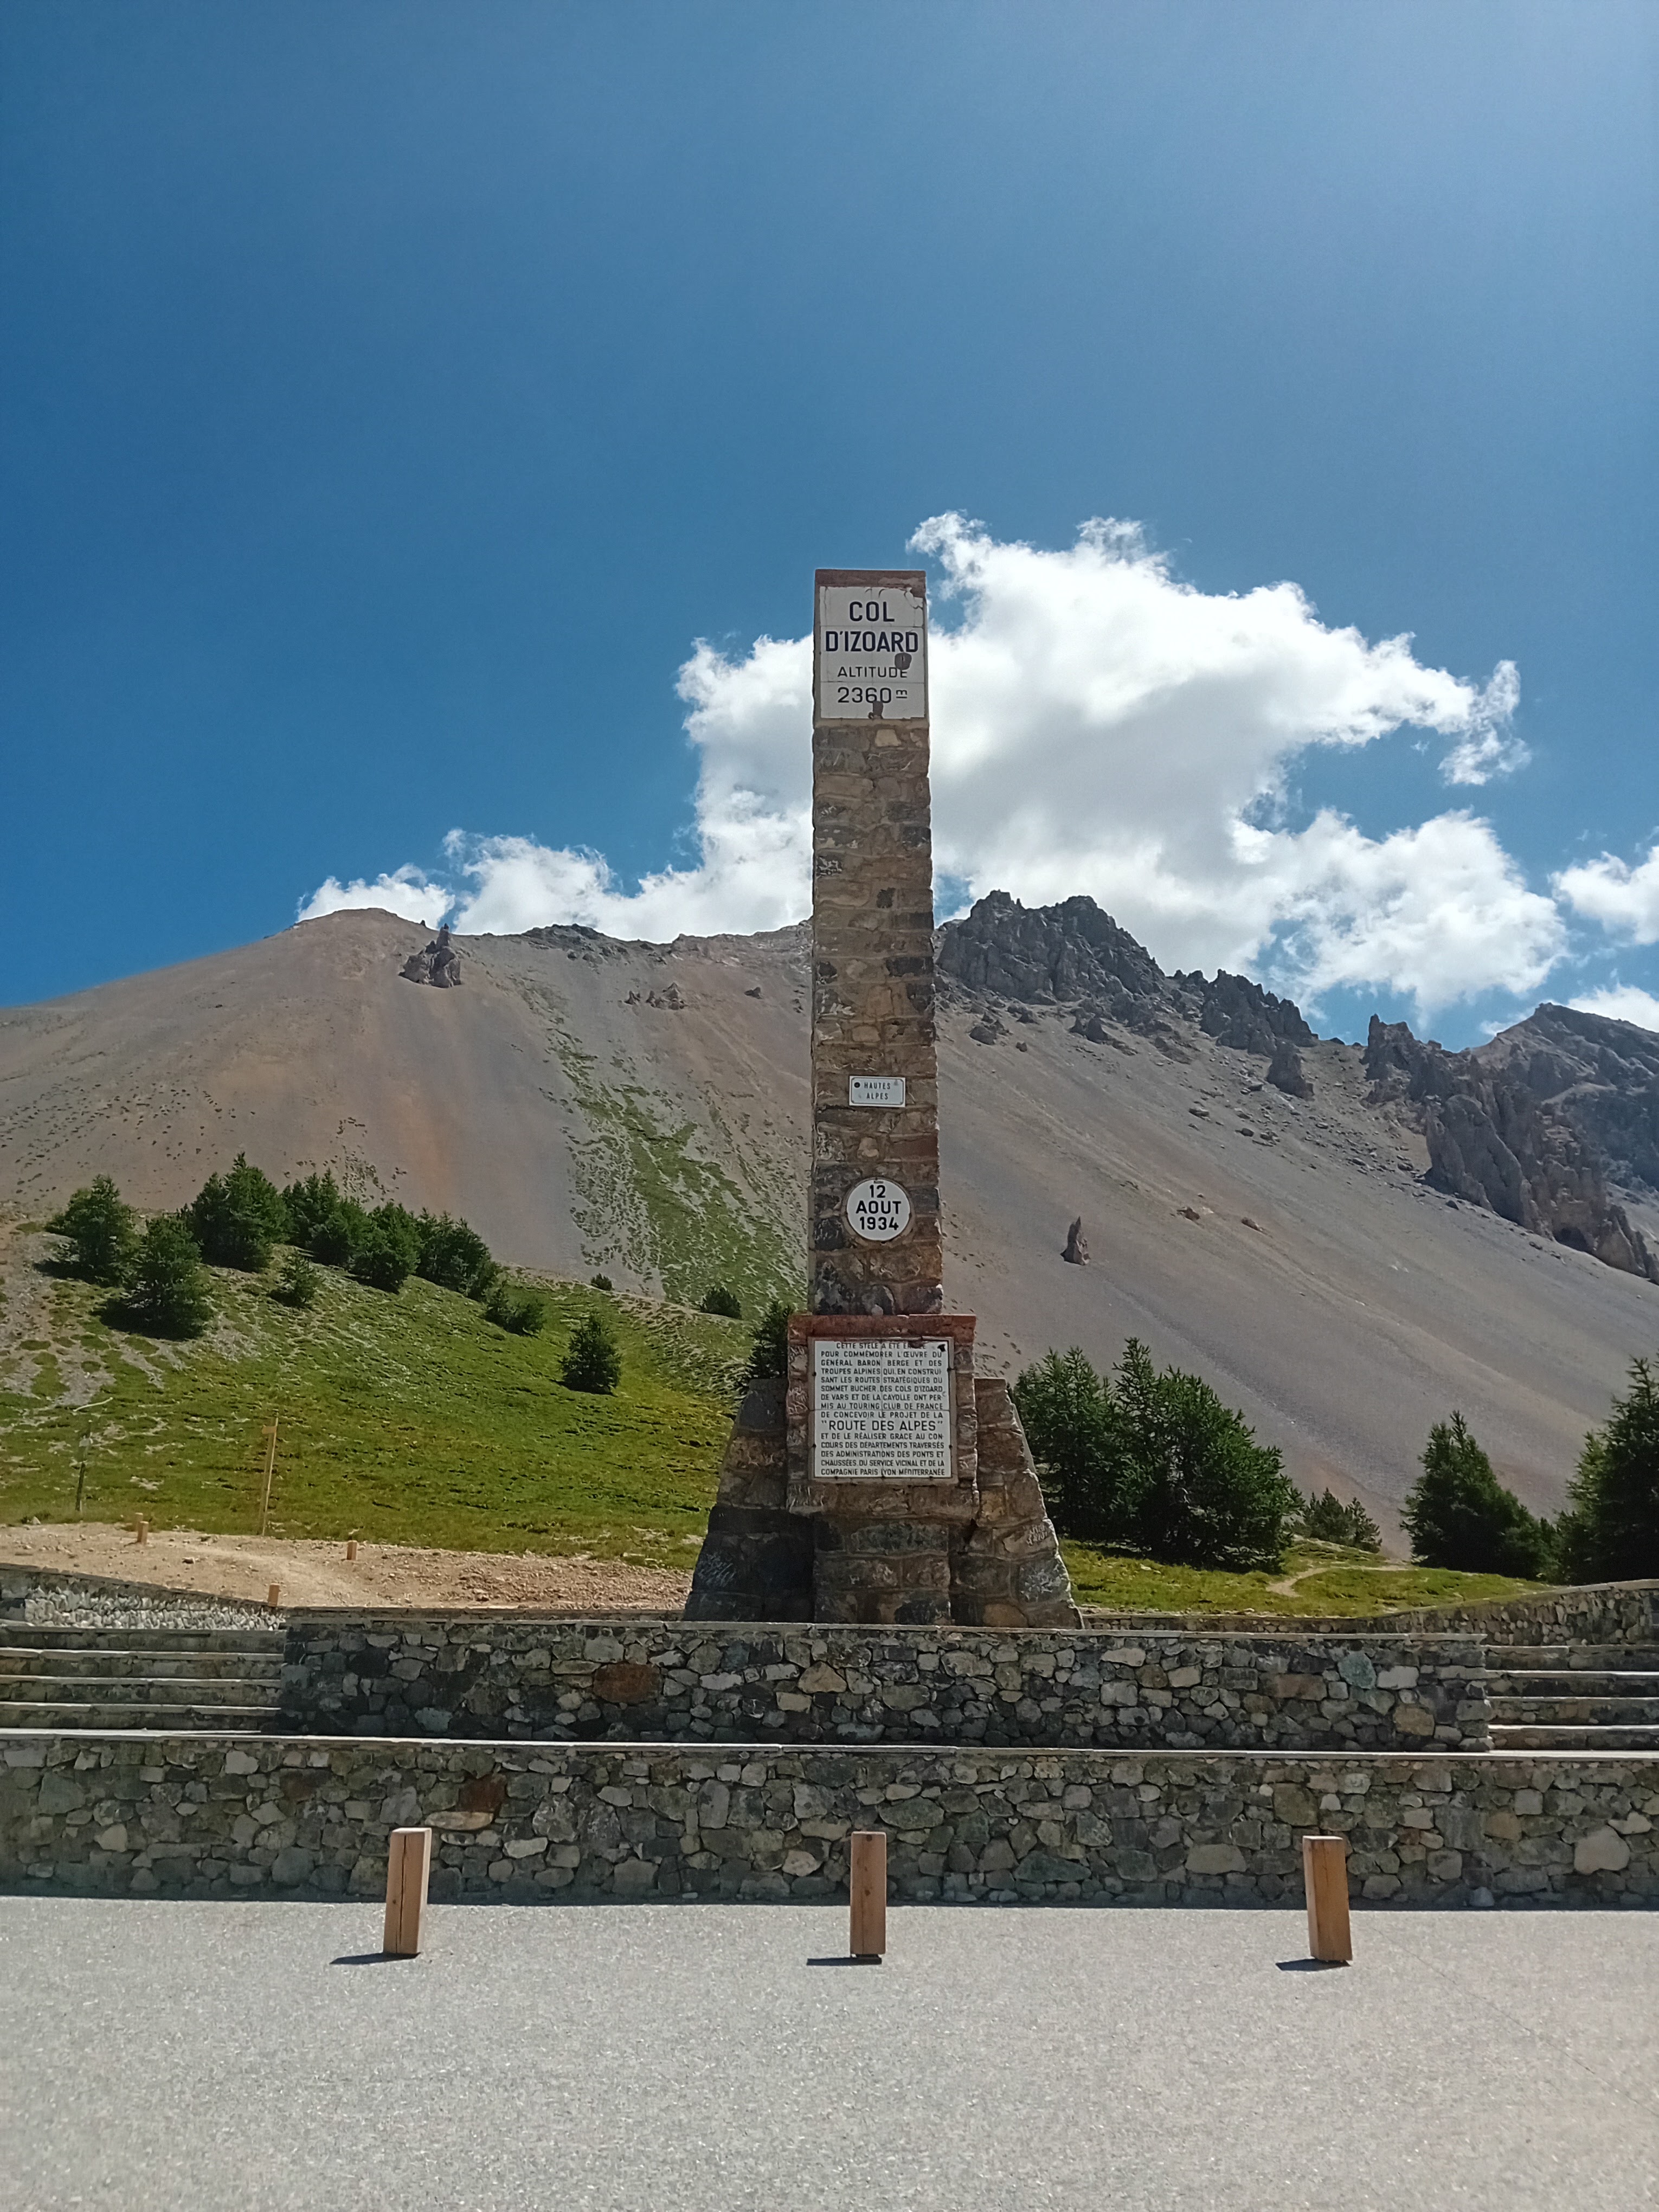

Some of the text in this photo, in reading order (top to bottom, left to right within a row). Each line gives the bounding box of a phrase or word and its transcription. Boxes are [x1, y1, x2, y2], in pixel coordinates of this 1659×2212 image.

[849, 601, 895, 622] COL
[825, 631, 918, 652] D'IZOARD
[838, 666, 908, 678] ALTITUDE
[838, 687, 892, 703] 2360
[870, 1185, 886, 1198] 12
[856, 1200, 901, 1214] AOUT
[859, 1217, 899, 1231] 1934
[872, 1420, 894, 1431] DES
